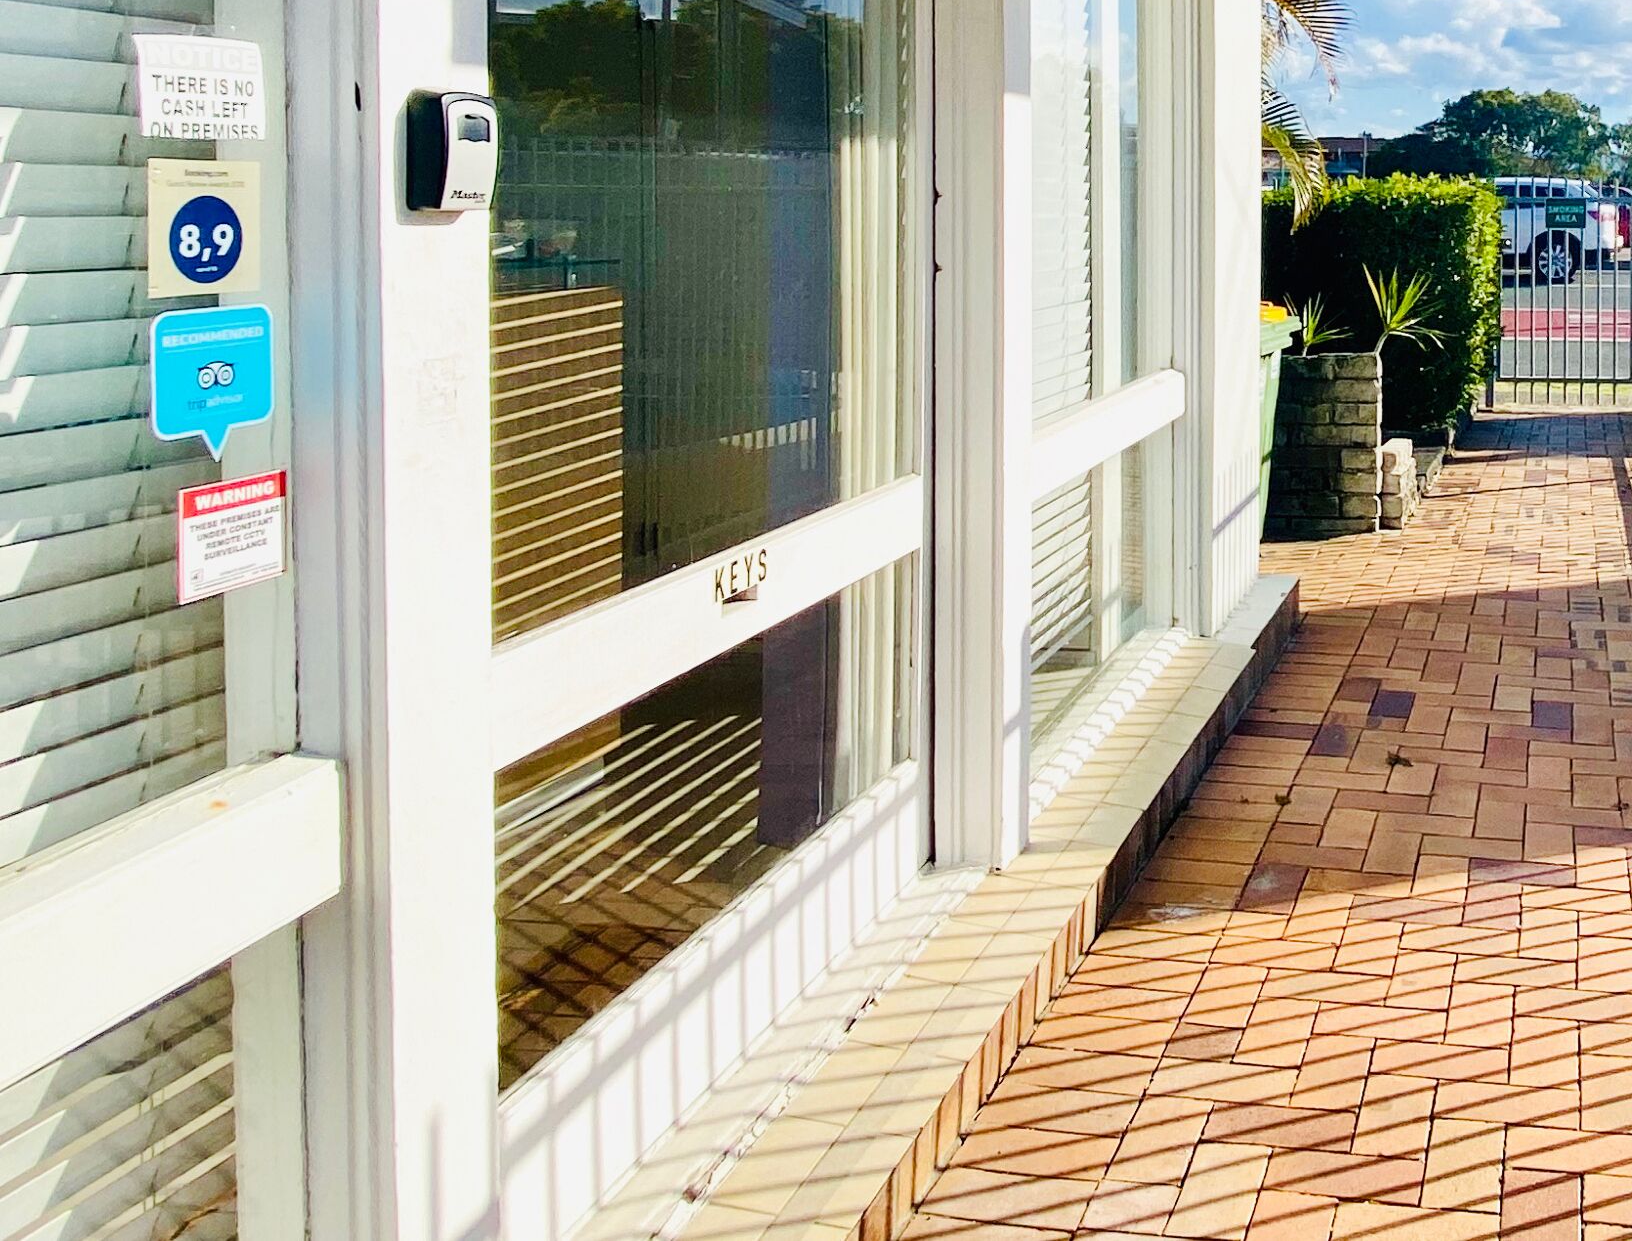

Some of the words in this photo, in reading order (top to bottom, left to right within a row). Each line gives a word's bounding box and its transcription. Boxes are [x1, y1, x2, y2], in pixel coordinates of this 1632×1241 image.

[146, 43, 257, 71] NOTICE
[152, 74, 207, 94] THERE
[213, 78, 229, 95] IS
[234, 79, 254, 97] NO
[161, 98, 206, 117] CASH
[212, 100, 248, 118] LEFT
[150, 121, 173, 137] ON
[181, 122, 259, 140] PREMISES
[1554, 214, 1577, 222] AREA
[178, 223, 234, 262] 8,9
[162, 326, 264, 348] RECOMMENDED
[195, 480, 275, 510] WARNING
[190, 520, 218, 532] THESE
[221, 510, 262, 525] PREMISES
[265, 504, 280, 514] ARE
[197, 528, 227, 541] UNDER
[229, 516, 274, 533] CONSTANT
[204, 538, 268, 560] SURVEILLANCE
[206, 535, 241, 549] REMOTE
[244, 528, 266, 539] CCTV
[714, 548, 767, 602] KEYS
